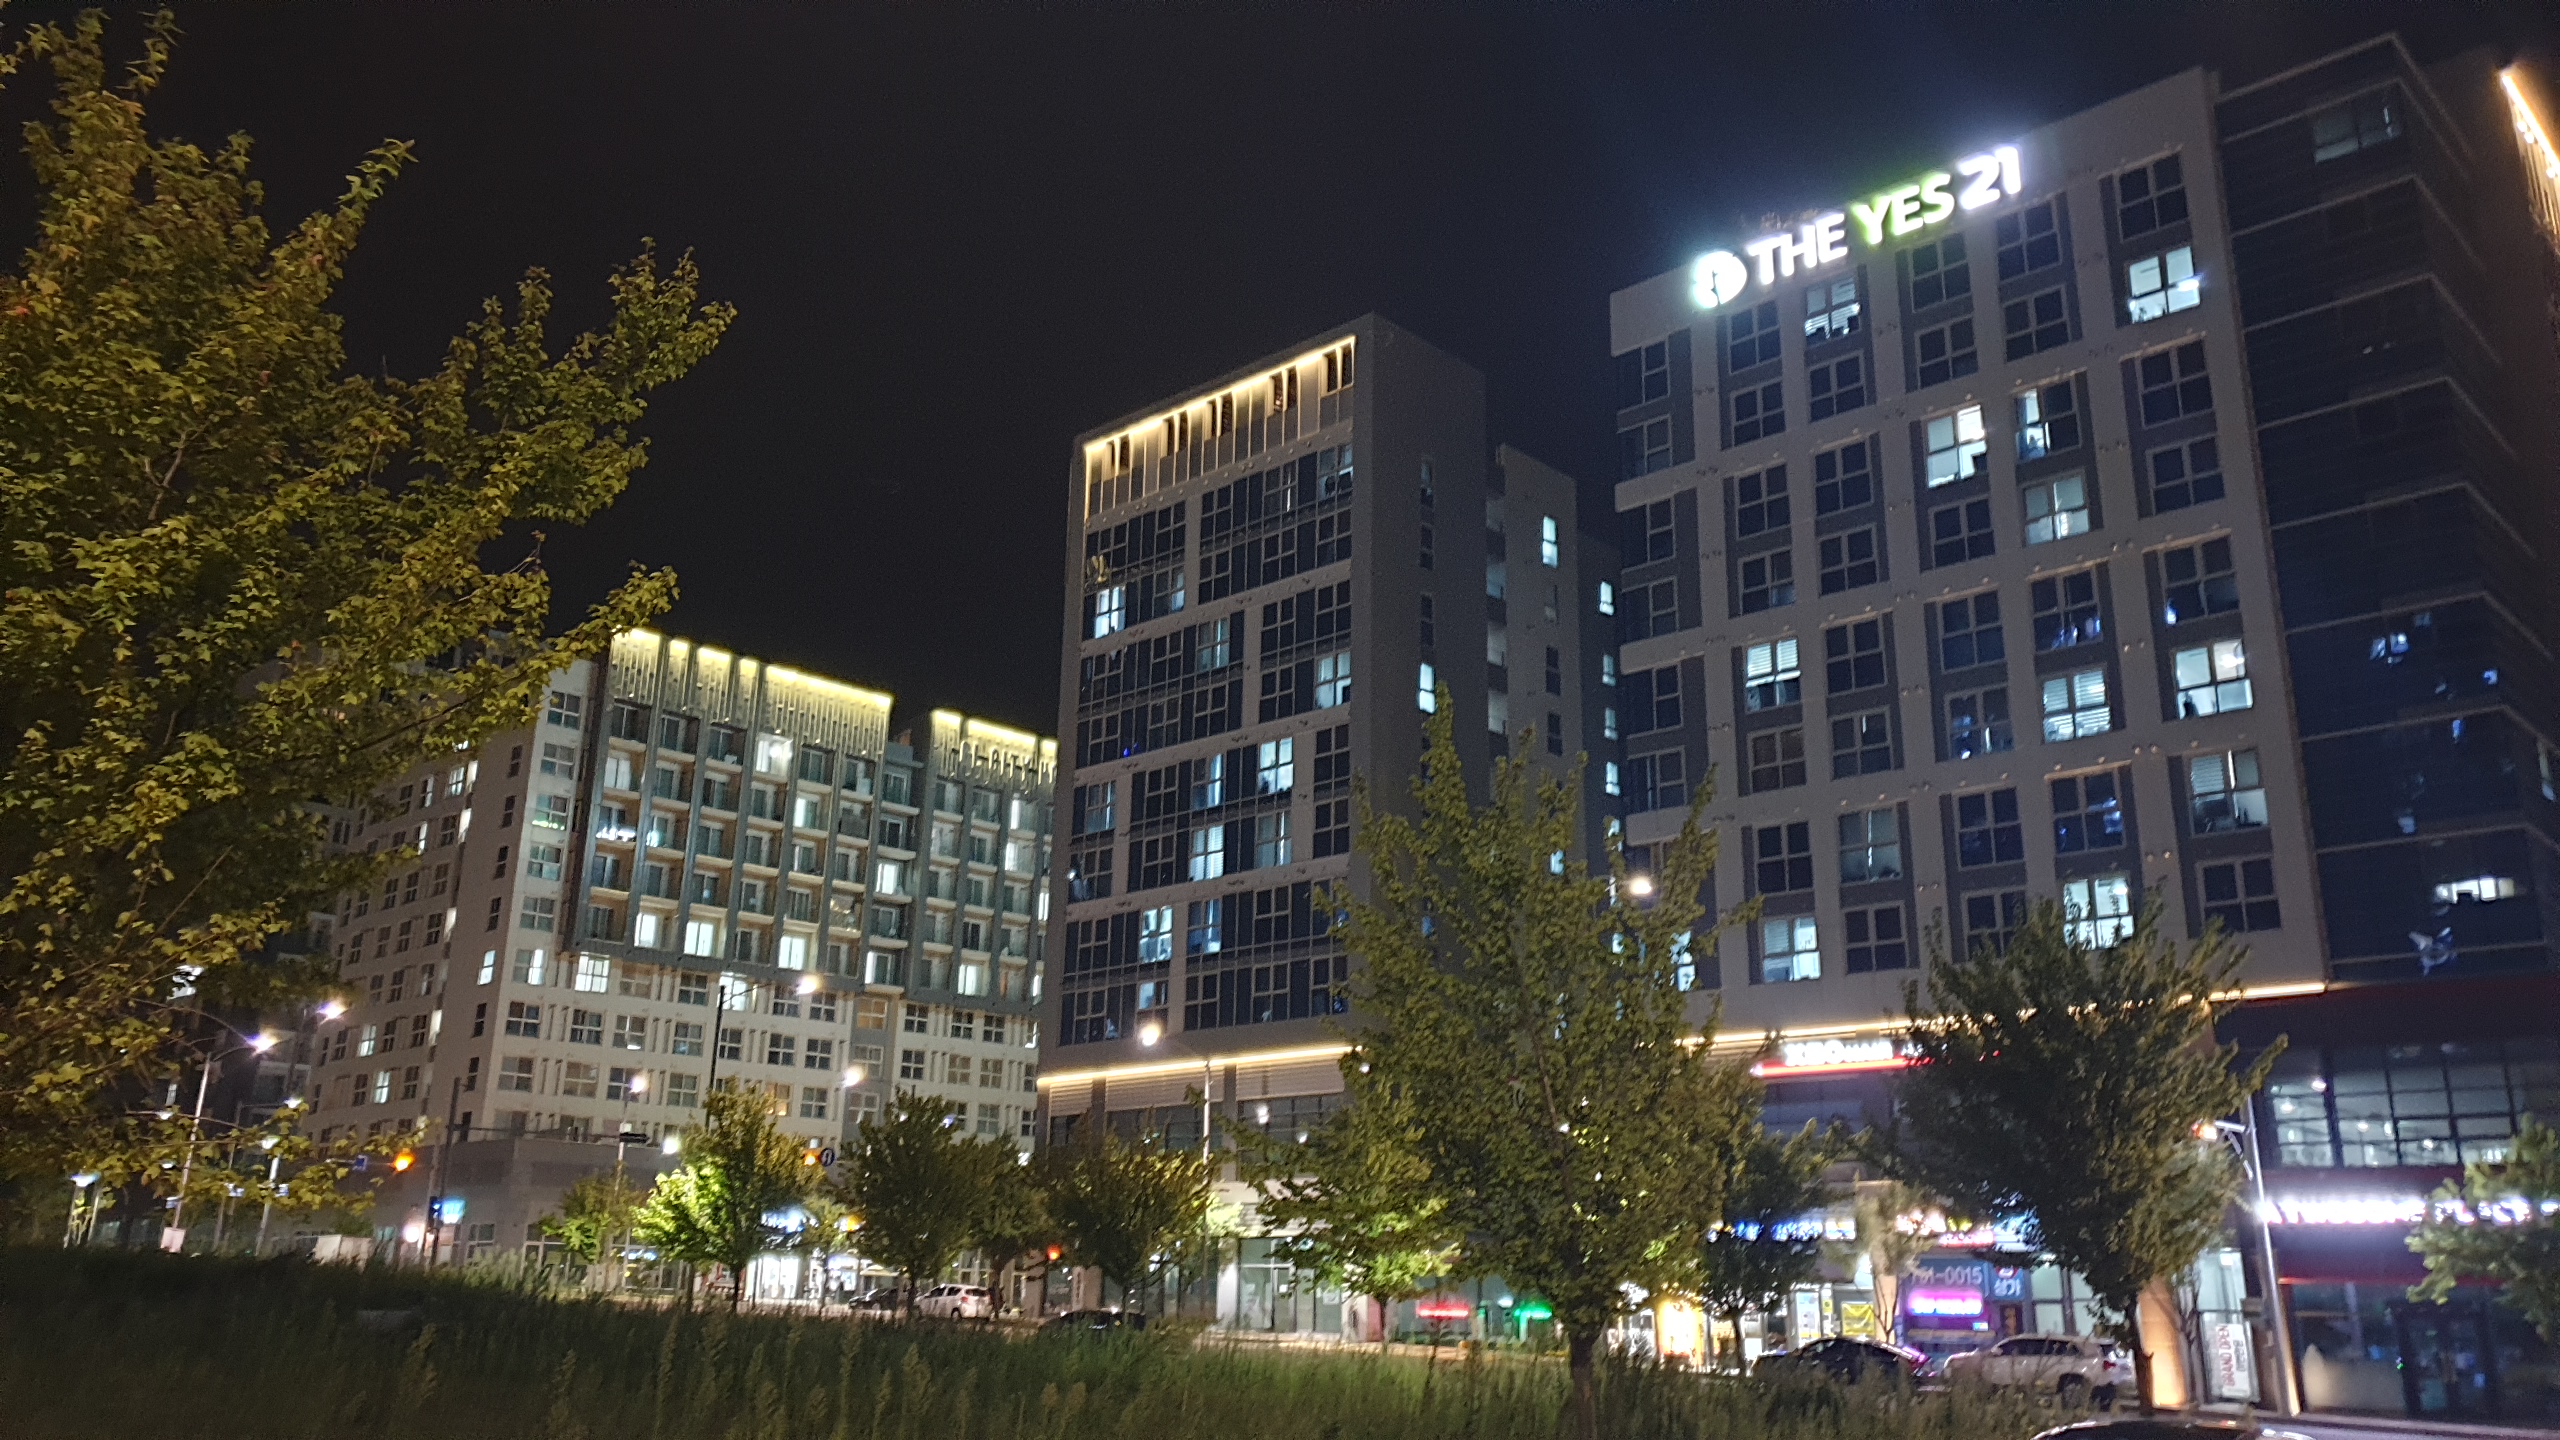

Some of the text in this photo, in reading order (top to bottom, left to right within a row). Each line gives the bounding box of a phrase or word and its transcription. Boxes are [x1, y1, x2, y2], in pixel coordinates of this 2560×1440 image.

[1747, 145, 2022, 286] THE YES 21
